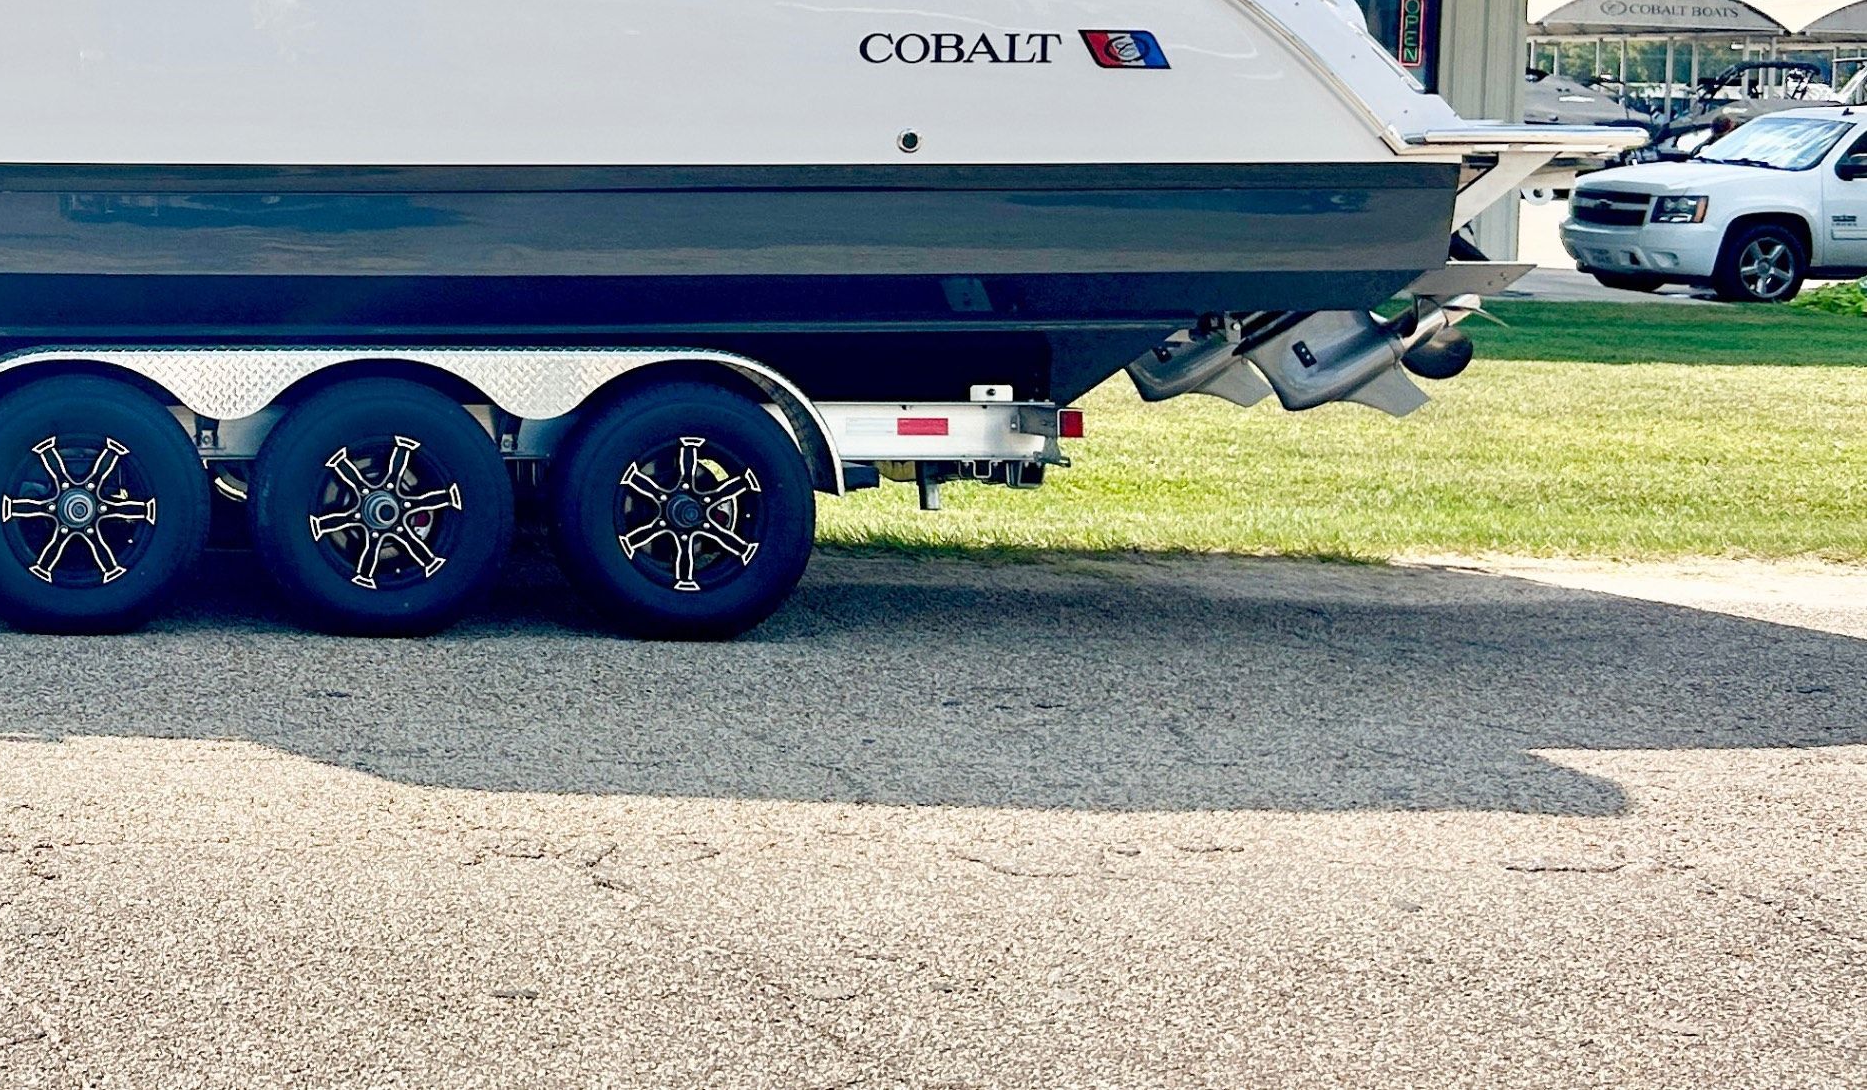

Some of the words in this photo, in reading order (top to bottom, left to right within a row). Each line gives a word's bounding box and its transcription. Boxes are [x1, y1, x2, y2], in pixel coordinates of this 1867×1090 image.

[1629, 3, 1685, 16] COBALT
[1691, 6, 1739, 18] BOATS
[859, 32, 1063, 63] COBALT
